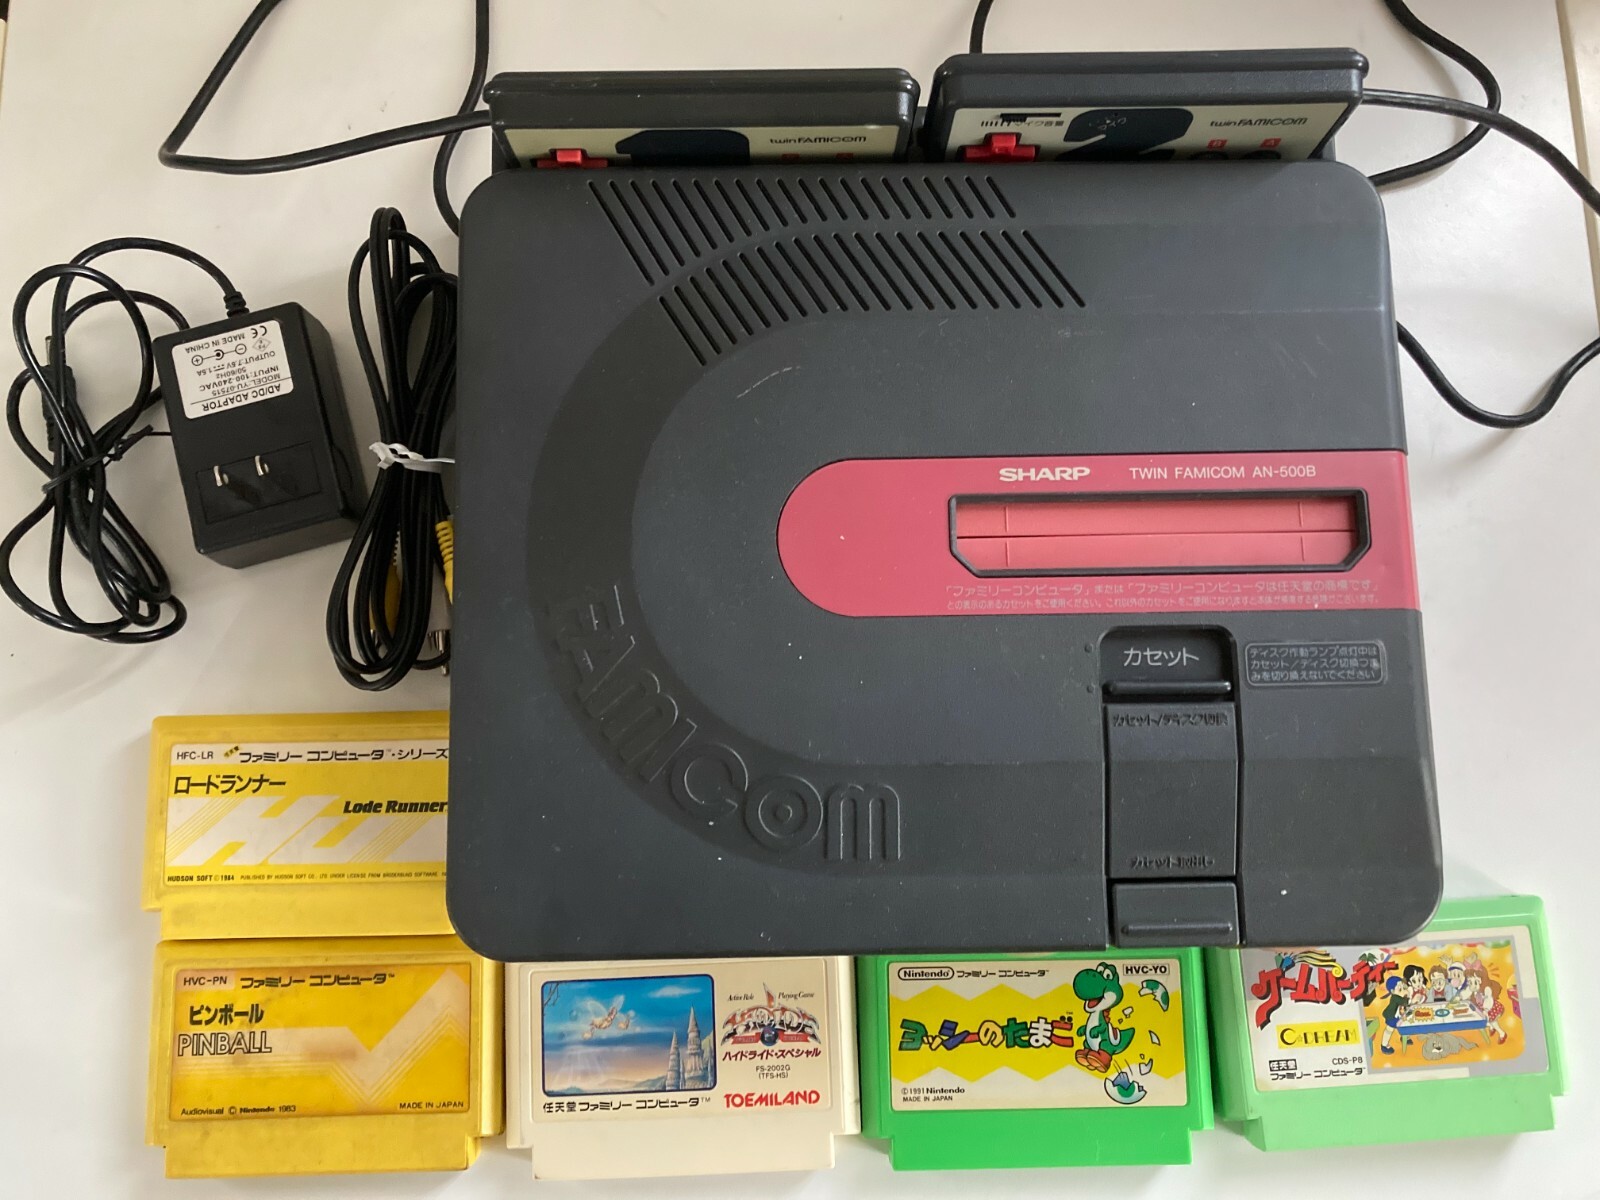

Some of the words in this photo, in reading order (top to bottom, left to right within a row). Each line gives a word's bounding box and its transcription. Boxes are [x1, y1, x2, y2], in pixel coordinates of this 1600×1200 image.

[212, 338, 220, 347] IN
[222, 333, 245, 346] MADE
[185, 342, 211, 354] CHINA
[252, 383, 281, 399] AD/DC
[202, 393, 249, 412] ADAPTOR
[999, 467, 1091, 481] SHARP
[1129, 467, 1168, 480] TWIN
[1174, 466, 1245, 479] FAMICOM
[1252, 465, 1317, 478] AN-500B
[1123, 647, 1200, 667] カセット
[176, 751, 214, 760] HFC-LR
[174, 774, 286, 795] ロードランナー
[343, 800, 383, 814] Lode
[385, 800, 448, 813] Runner
[903, 969, 949, 978] Nintendo
[1125, 966, 1167, 974] HVC-YO
[183, 976, 227, 986] HVC-PN
[189, 1004, 264, 1026] ピンボール
[898, 1015, 1074, 1051] ヨッシーのたまご
[178, 1031, 272, 1056] PINBALL
[722, 1048, 821, 1061] ハイドライド・スペシャル
[1270, 1060, 1297, 1071] 任天堂
[724, 1090, 820, 1108] TOEMILAND
[181, 1107, 224, 1116] Audiovisual
[239, 1106, 275, 1114] Nintendo
